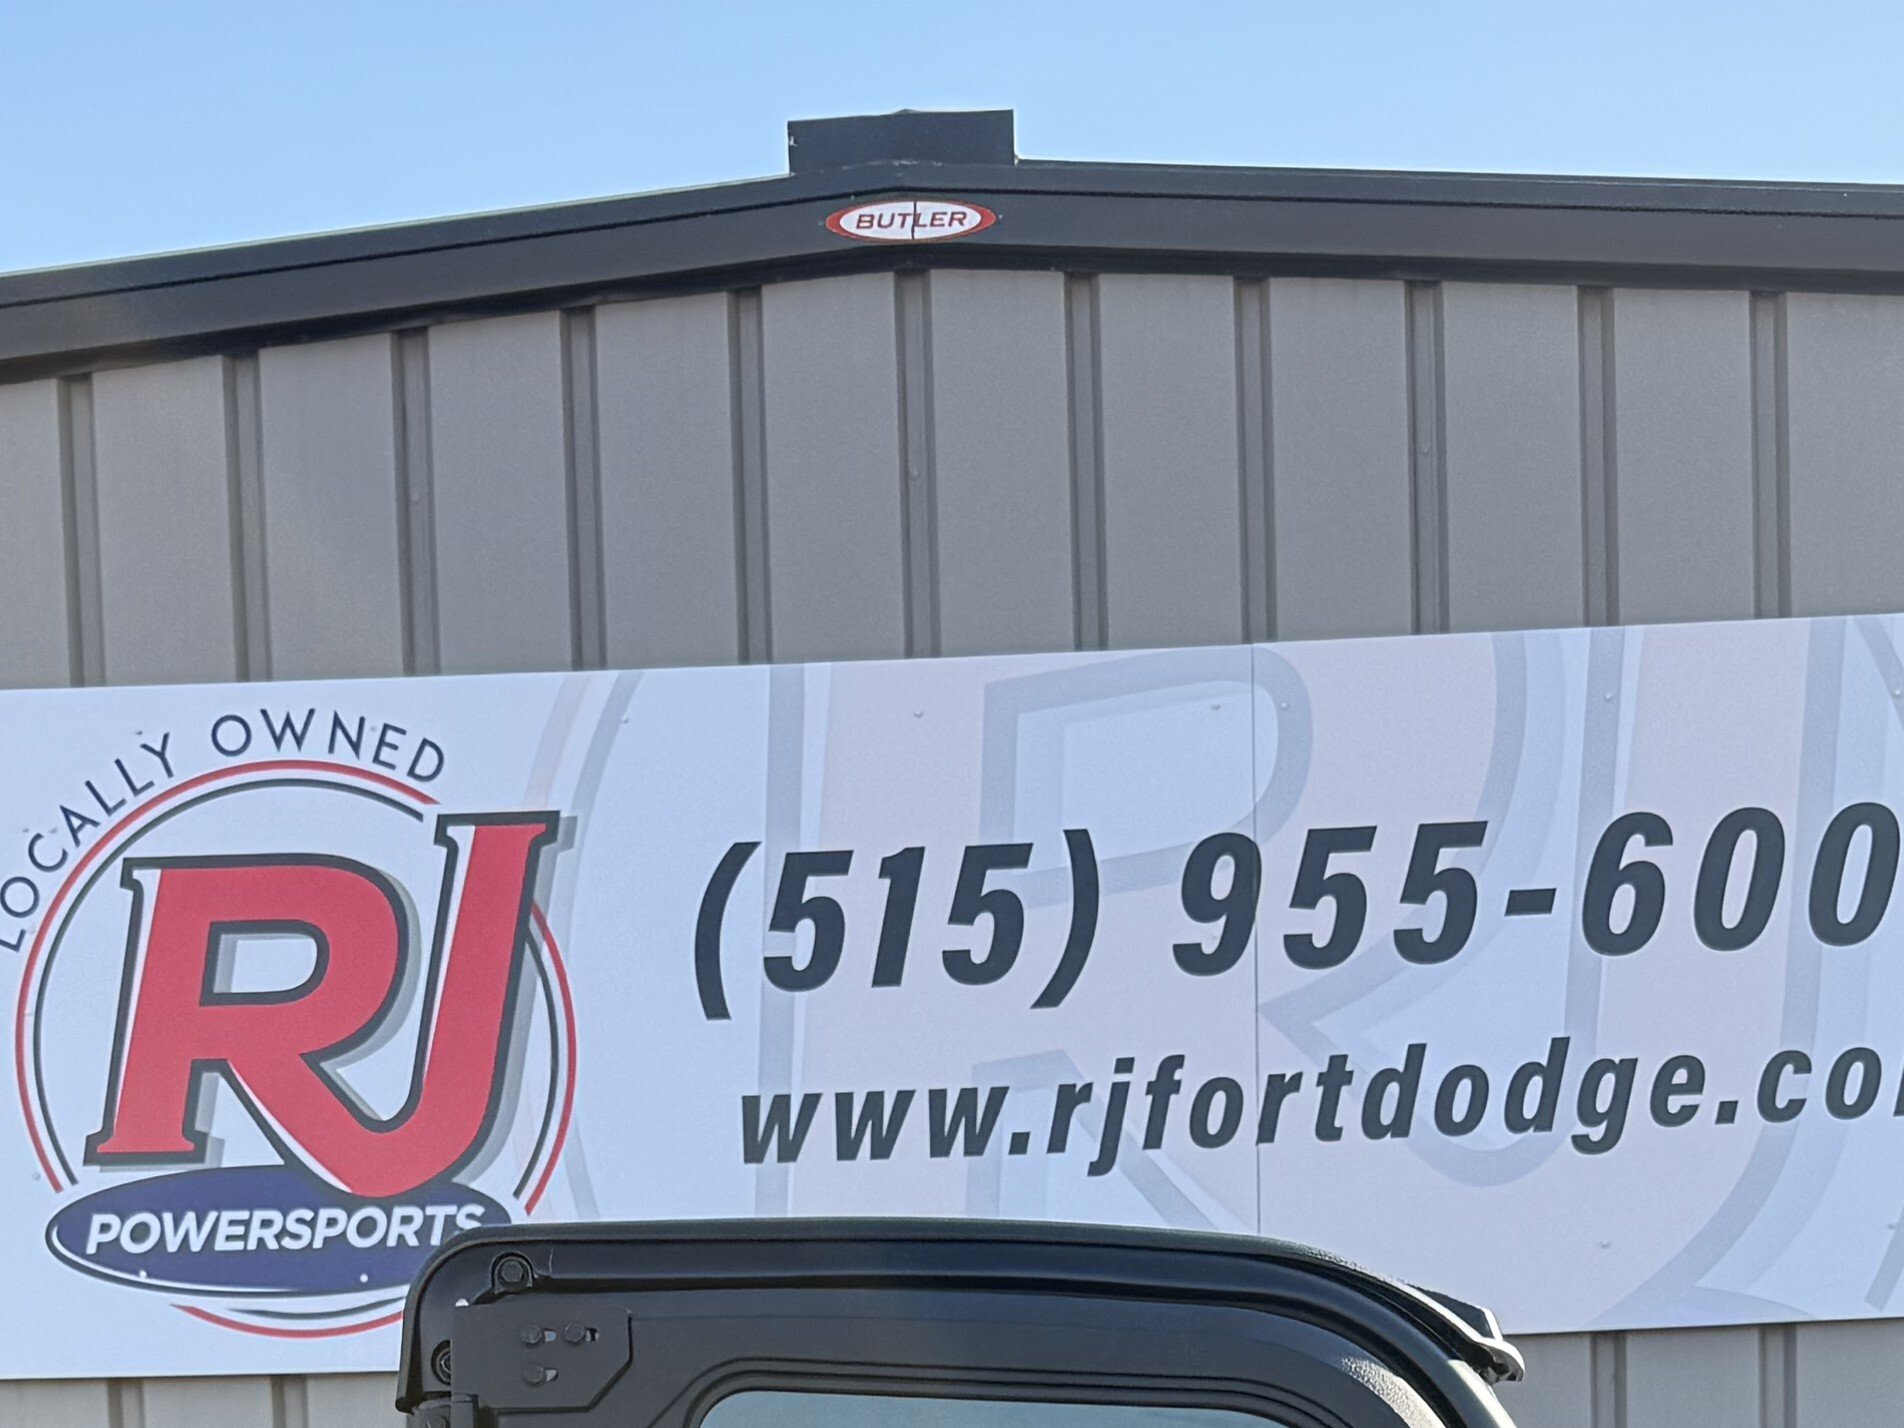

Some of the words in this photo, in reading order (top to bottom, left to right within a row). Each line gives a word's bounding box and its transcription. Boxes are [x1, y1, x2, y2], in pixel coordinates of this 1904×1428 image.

[856, 211, 969, 230] BUTLER
[209, 707, 446, 783] OWNED
[694, 828, 1100, 1021] (515)
[82, 809, 562, 1199] RJ
[85, 1202, 486, 1254] POWERSPORTS
